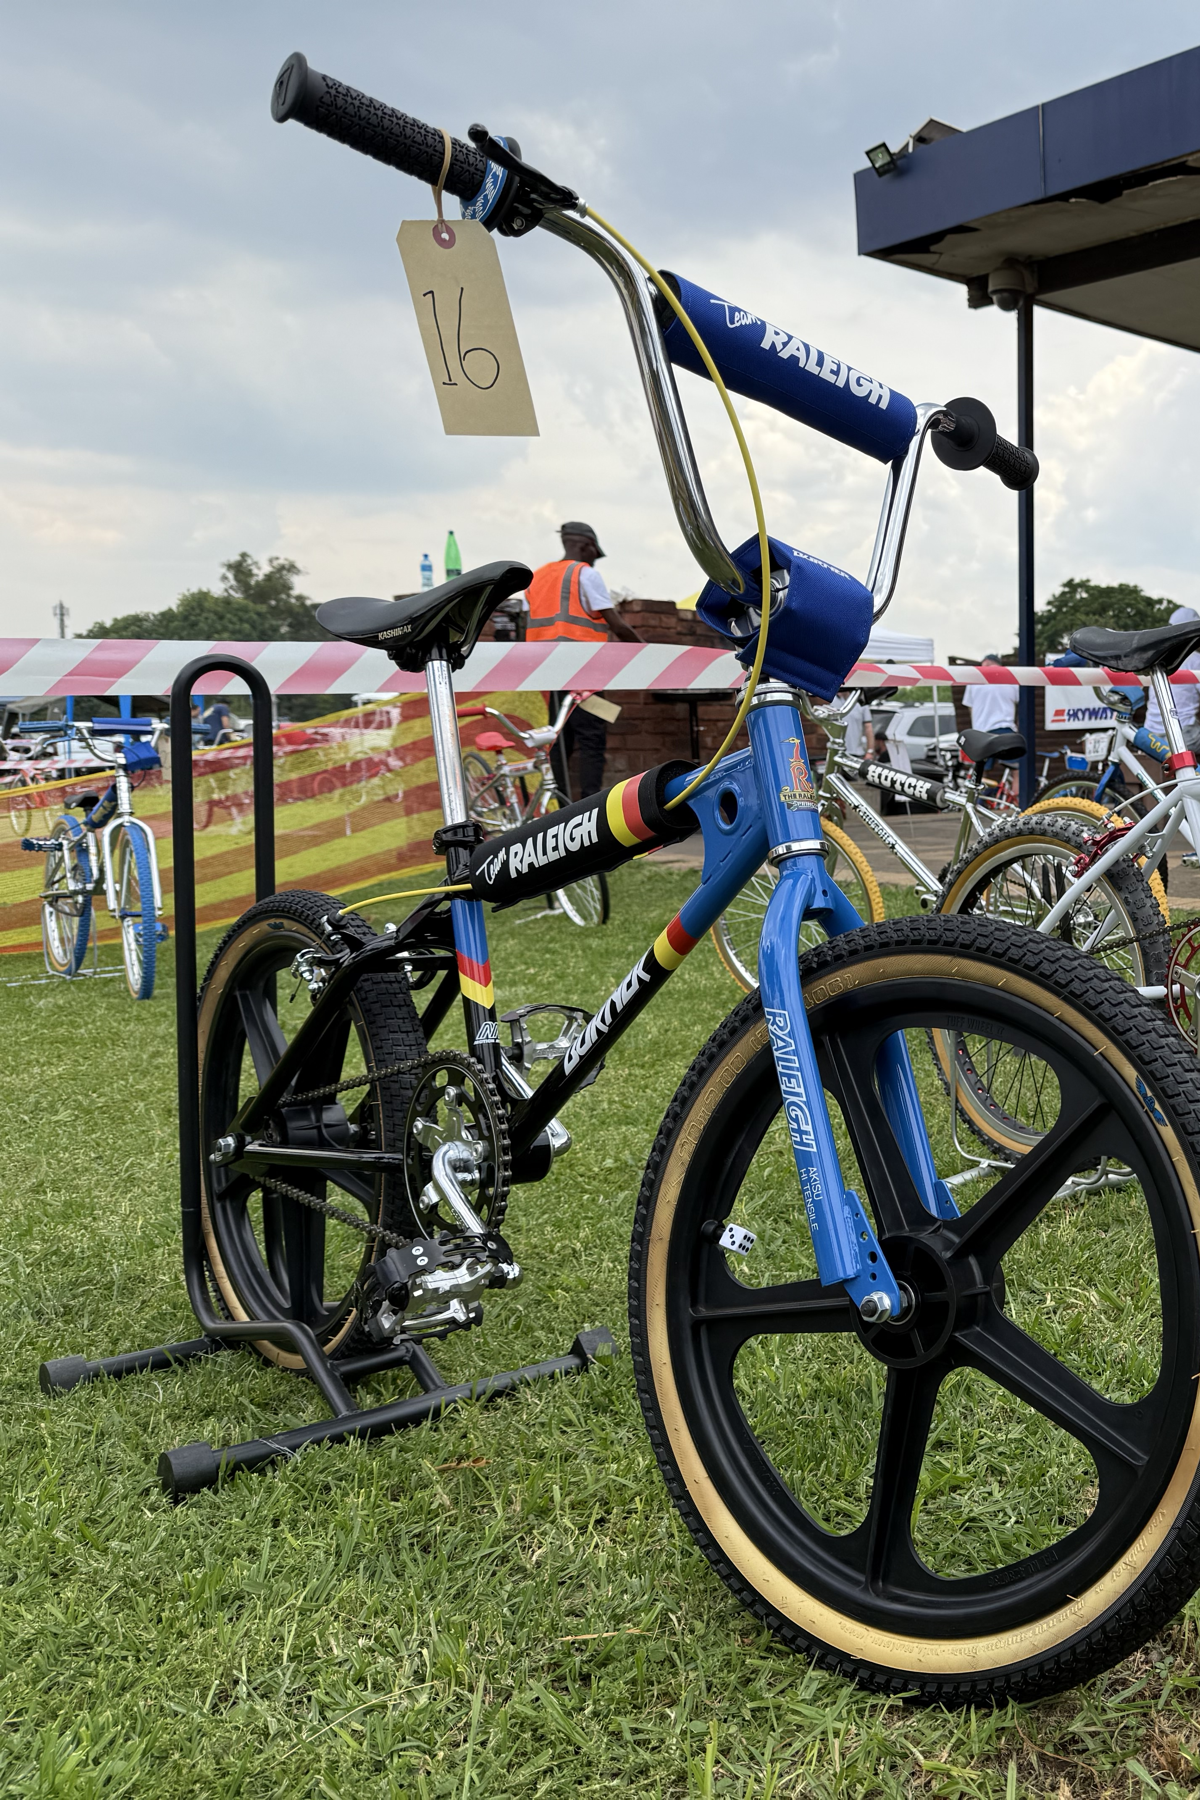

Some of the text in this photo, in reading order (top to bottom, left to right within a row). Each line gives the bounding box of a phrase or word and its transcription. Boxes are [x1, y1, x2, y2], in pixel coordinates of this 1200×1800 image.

[422, 286, 501, 390] 16
[709, 299, 891, 411] Team RALEIGH
[378, 624, 412, 641] KASHIMAX
[866, 764, 932, 800] HUTCH
[476, 807, 600, 886] Team RALEIGH
[946, 1015, 966, 1029] TUFF
[967, 1017, 994, 1035] WHEEL
[764, 1007, 818, 1153] RALEIGH
[800, 1168, 819, 1233] HI TENSILE
[807, 1167, 824, 1201] AKISU
